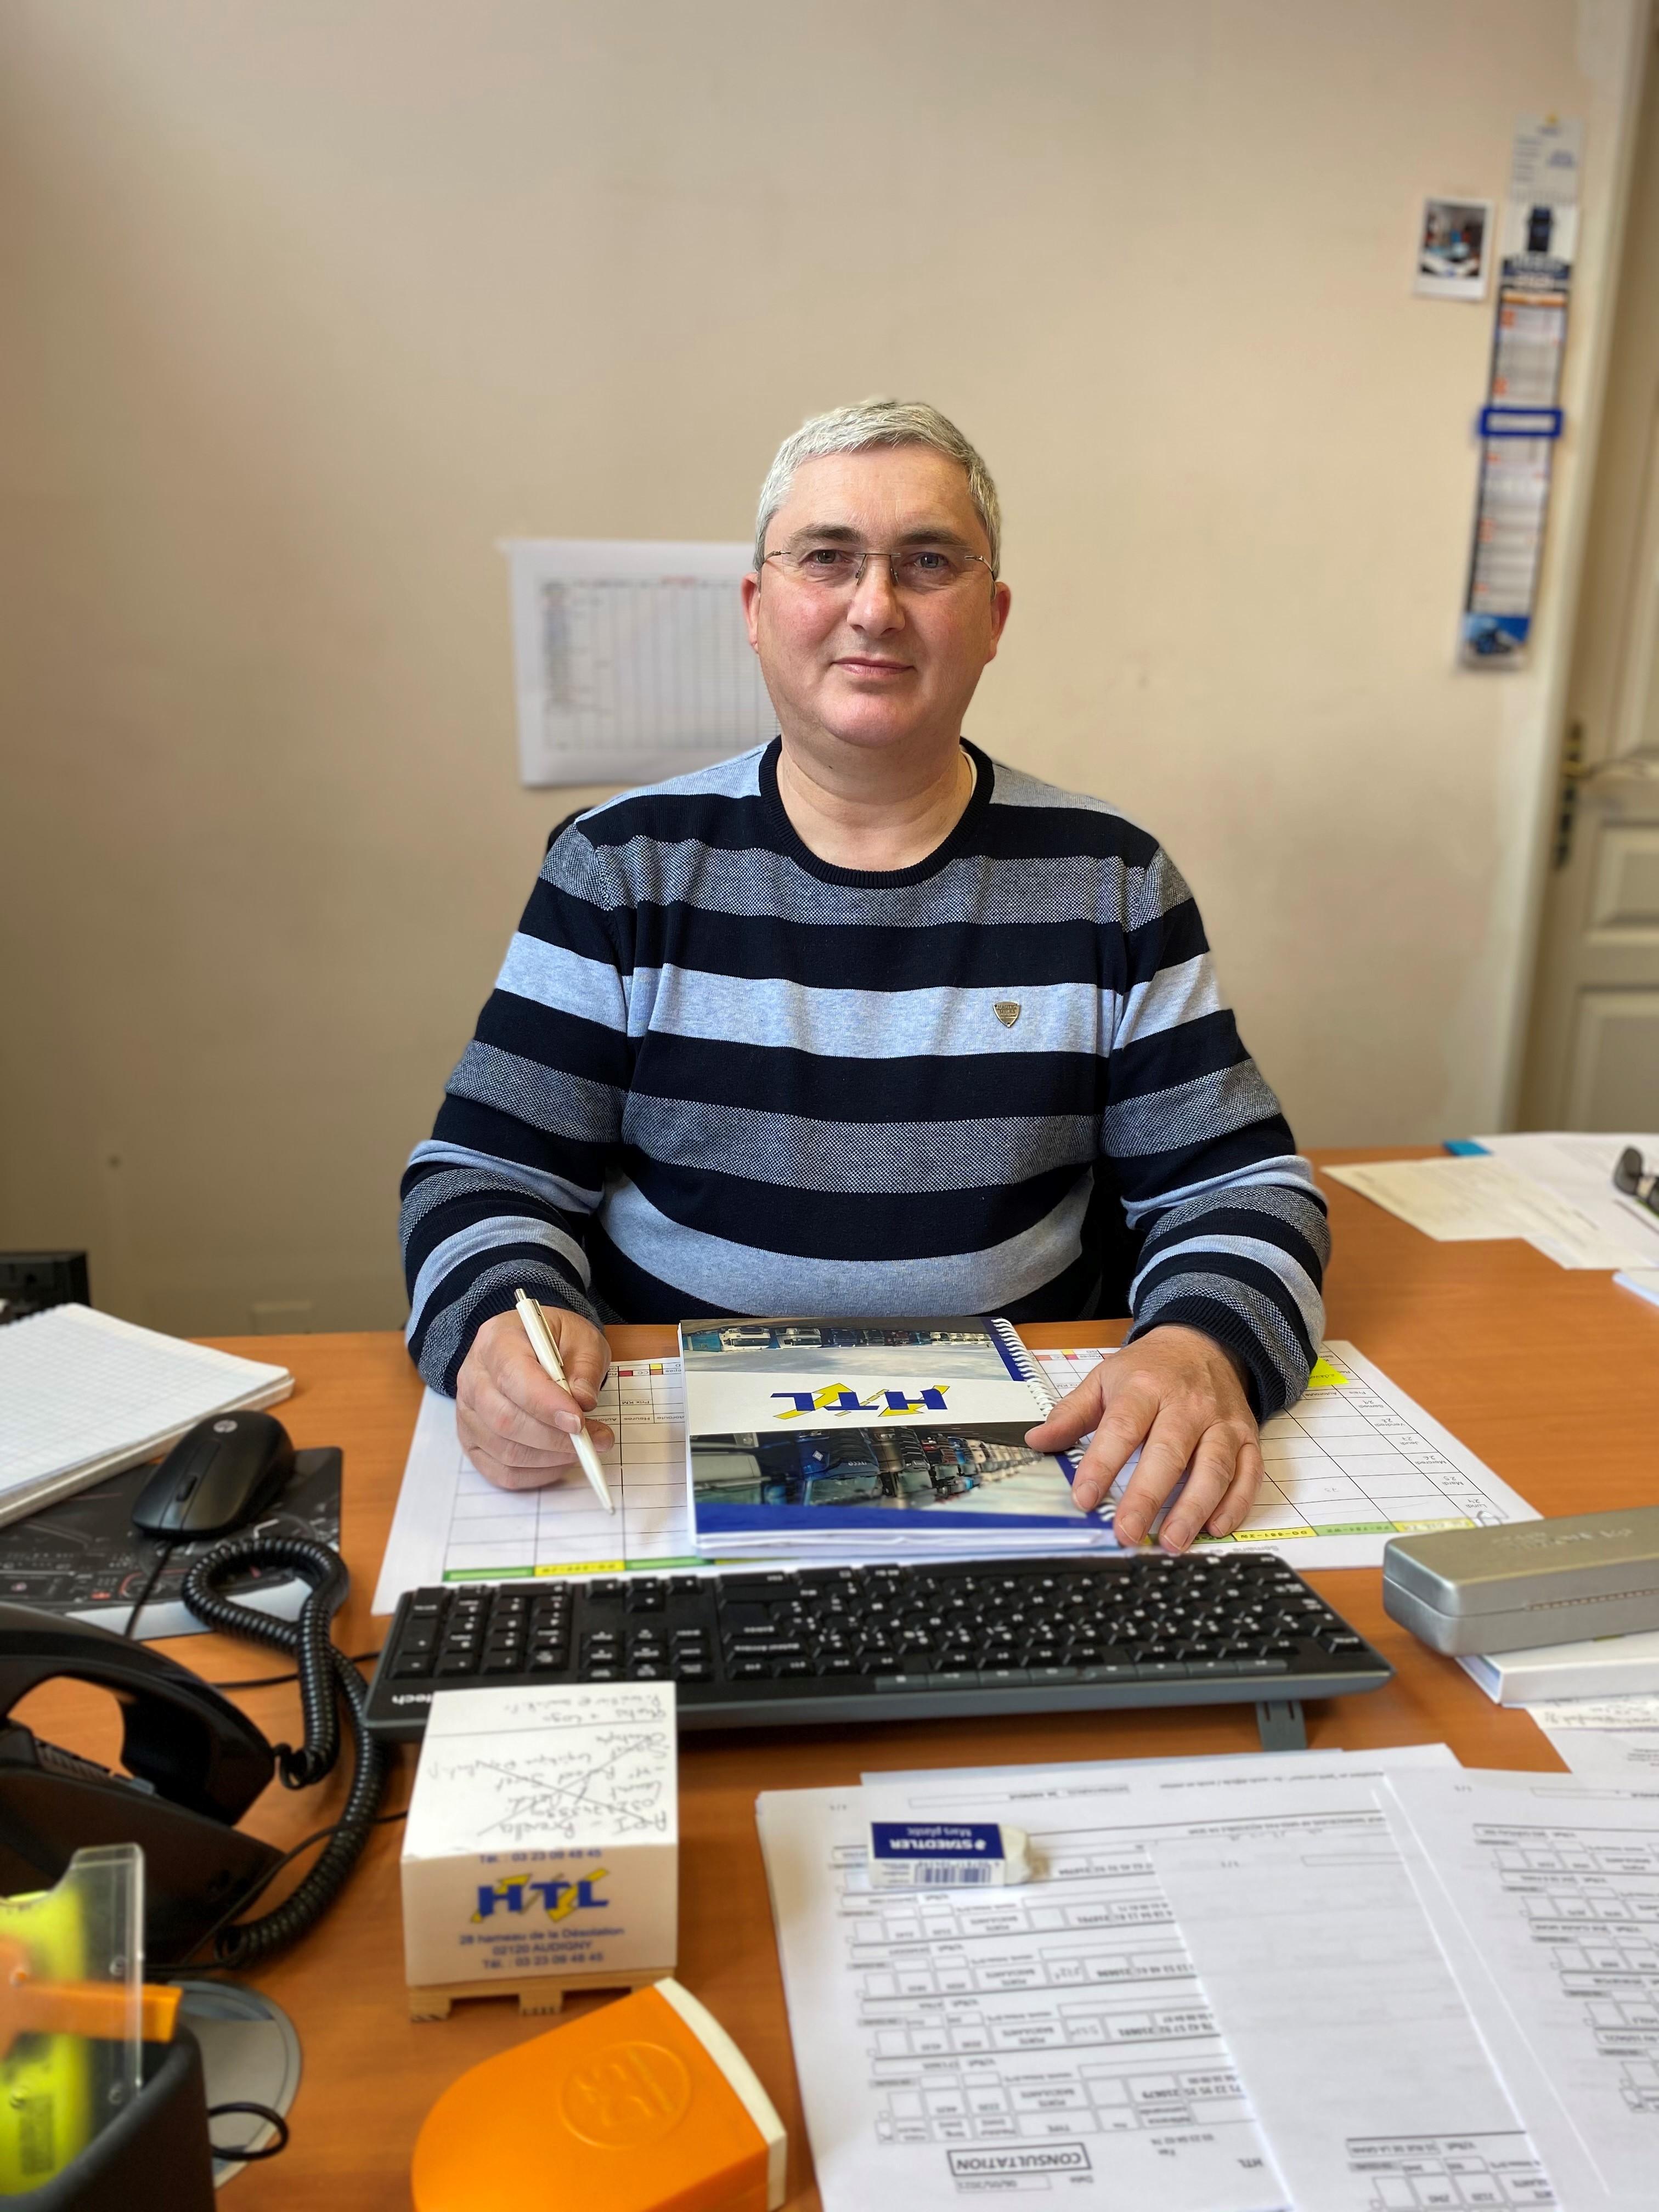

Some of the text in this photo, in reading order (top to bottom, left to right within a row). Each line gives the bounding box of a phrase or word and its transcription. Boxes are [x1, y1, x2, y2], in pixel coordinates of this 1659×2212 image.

[770, 1388, 948, 1412] HTL
[392, 1694, 432, 1706] tech
[907, 1826, 972, 1837] Mars plastic
[889, 1838, 973, 1850] STAEDTLER
[512, 1852, 527, 1861] 03
[531, 1851, 546, 1861] 23
[478, 1880, 609, 1917] HTL
[478, 1933, 527, 1943] hameau
[530, 1931, 545, 1940] de
[549, 1930, 559, 1939] la
[493, 1940, 592, 1955] 02120 AUDIGNY
[515, 1956, 530, 1967] 03
[534, 1955, 549, 1966] 23
[589, 1953, 604, 1962] 45
[1047, 2124, 1070, 2133] TYPE
[956, 2152, 1082, 2170] CONSULTATION
[1237, 2158, 1263, 2169] HTL
